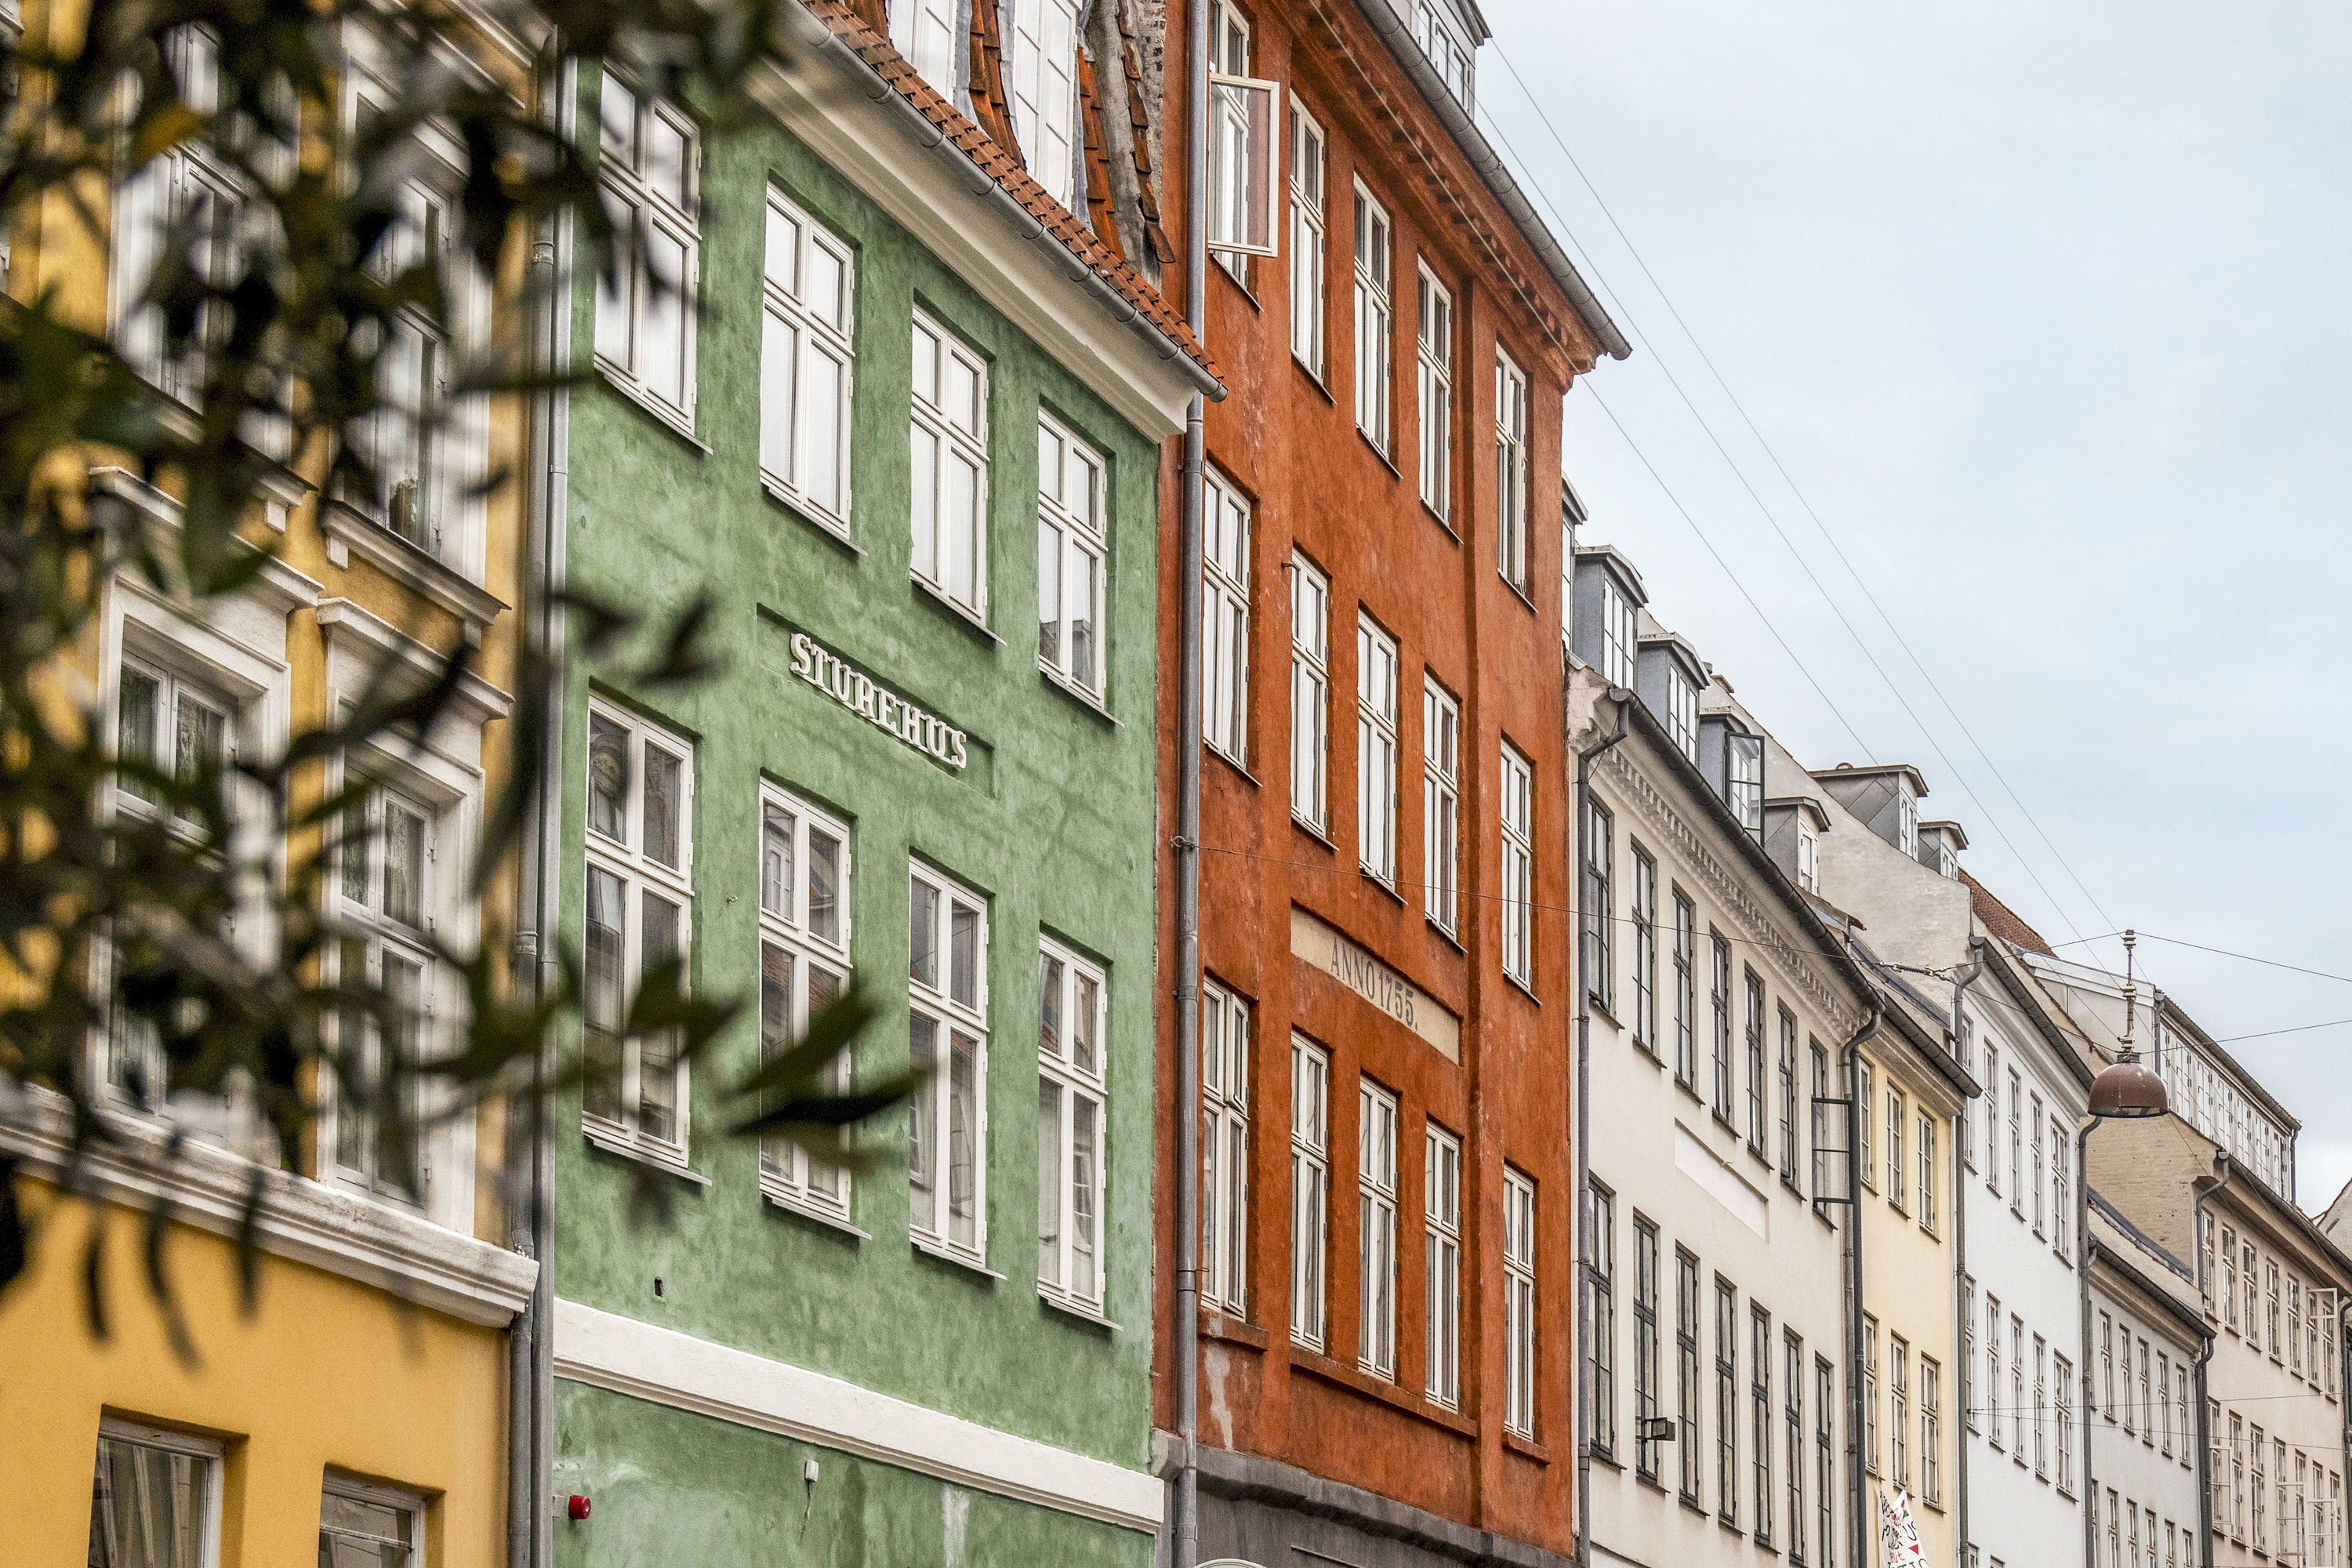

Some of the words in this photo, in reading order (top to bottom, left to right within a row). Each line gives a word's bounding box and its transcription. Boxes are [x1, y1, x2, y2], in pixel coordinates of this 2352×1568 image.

[789, 633, 967, 770] STUREHUS
[1330, 936, 1375, 1000] ANNO
[1378, 969, 1418, 1031] 1755.
